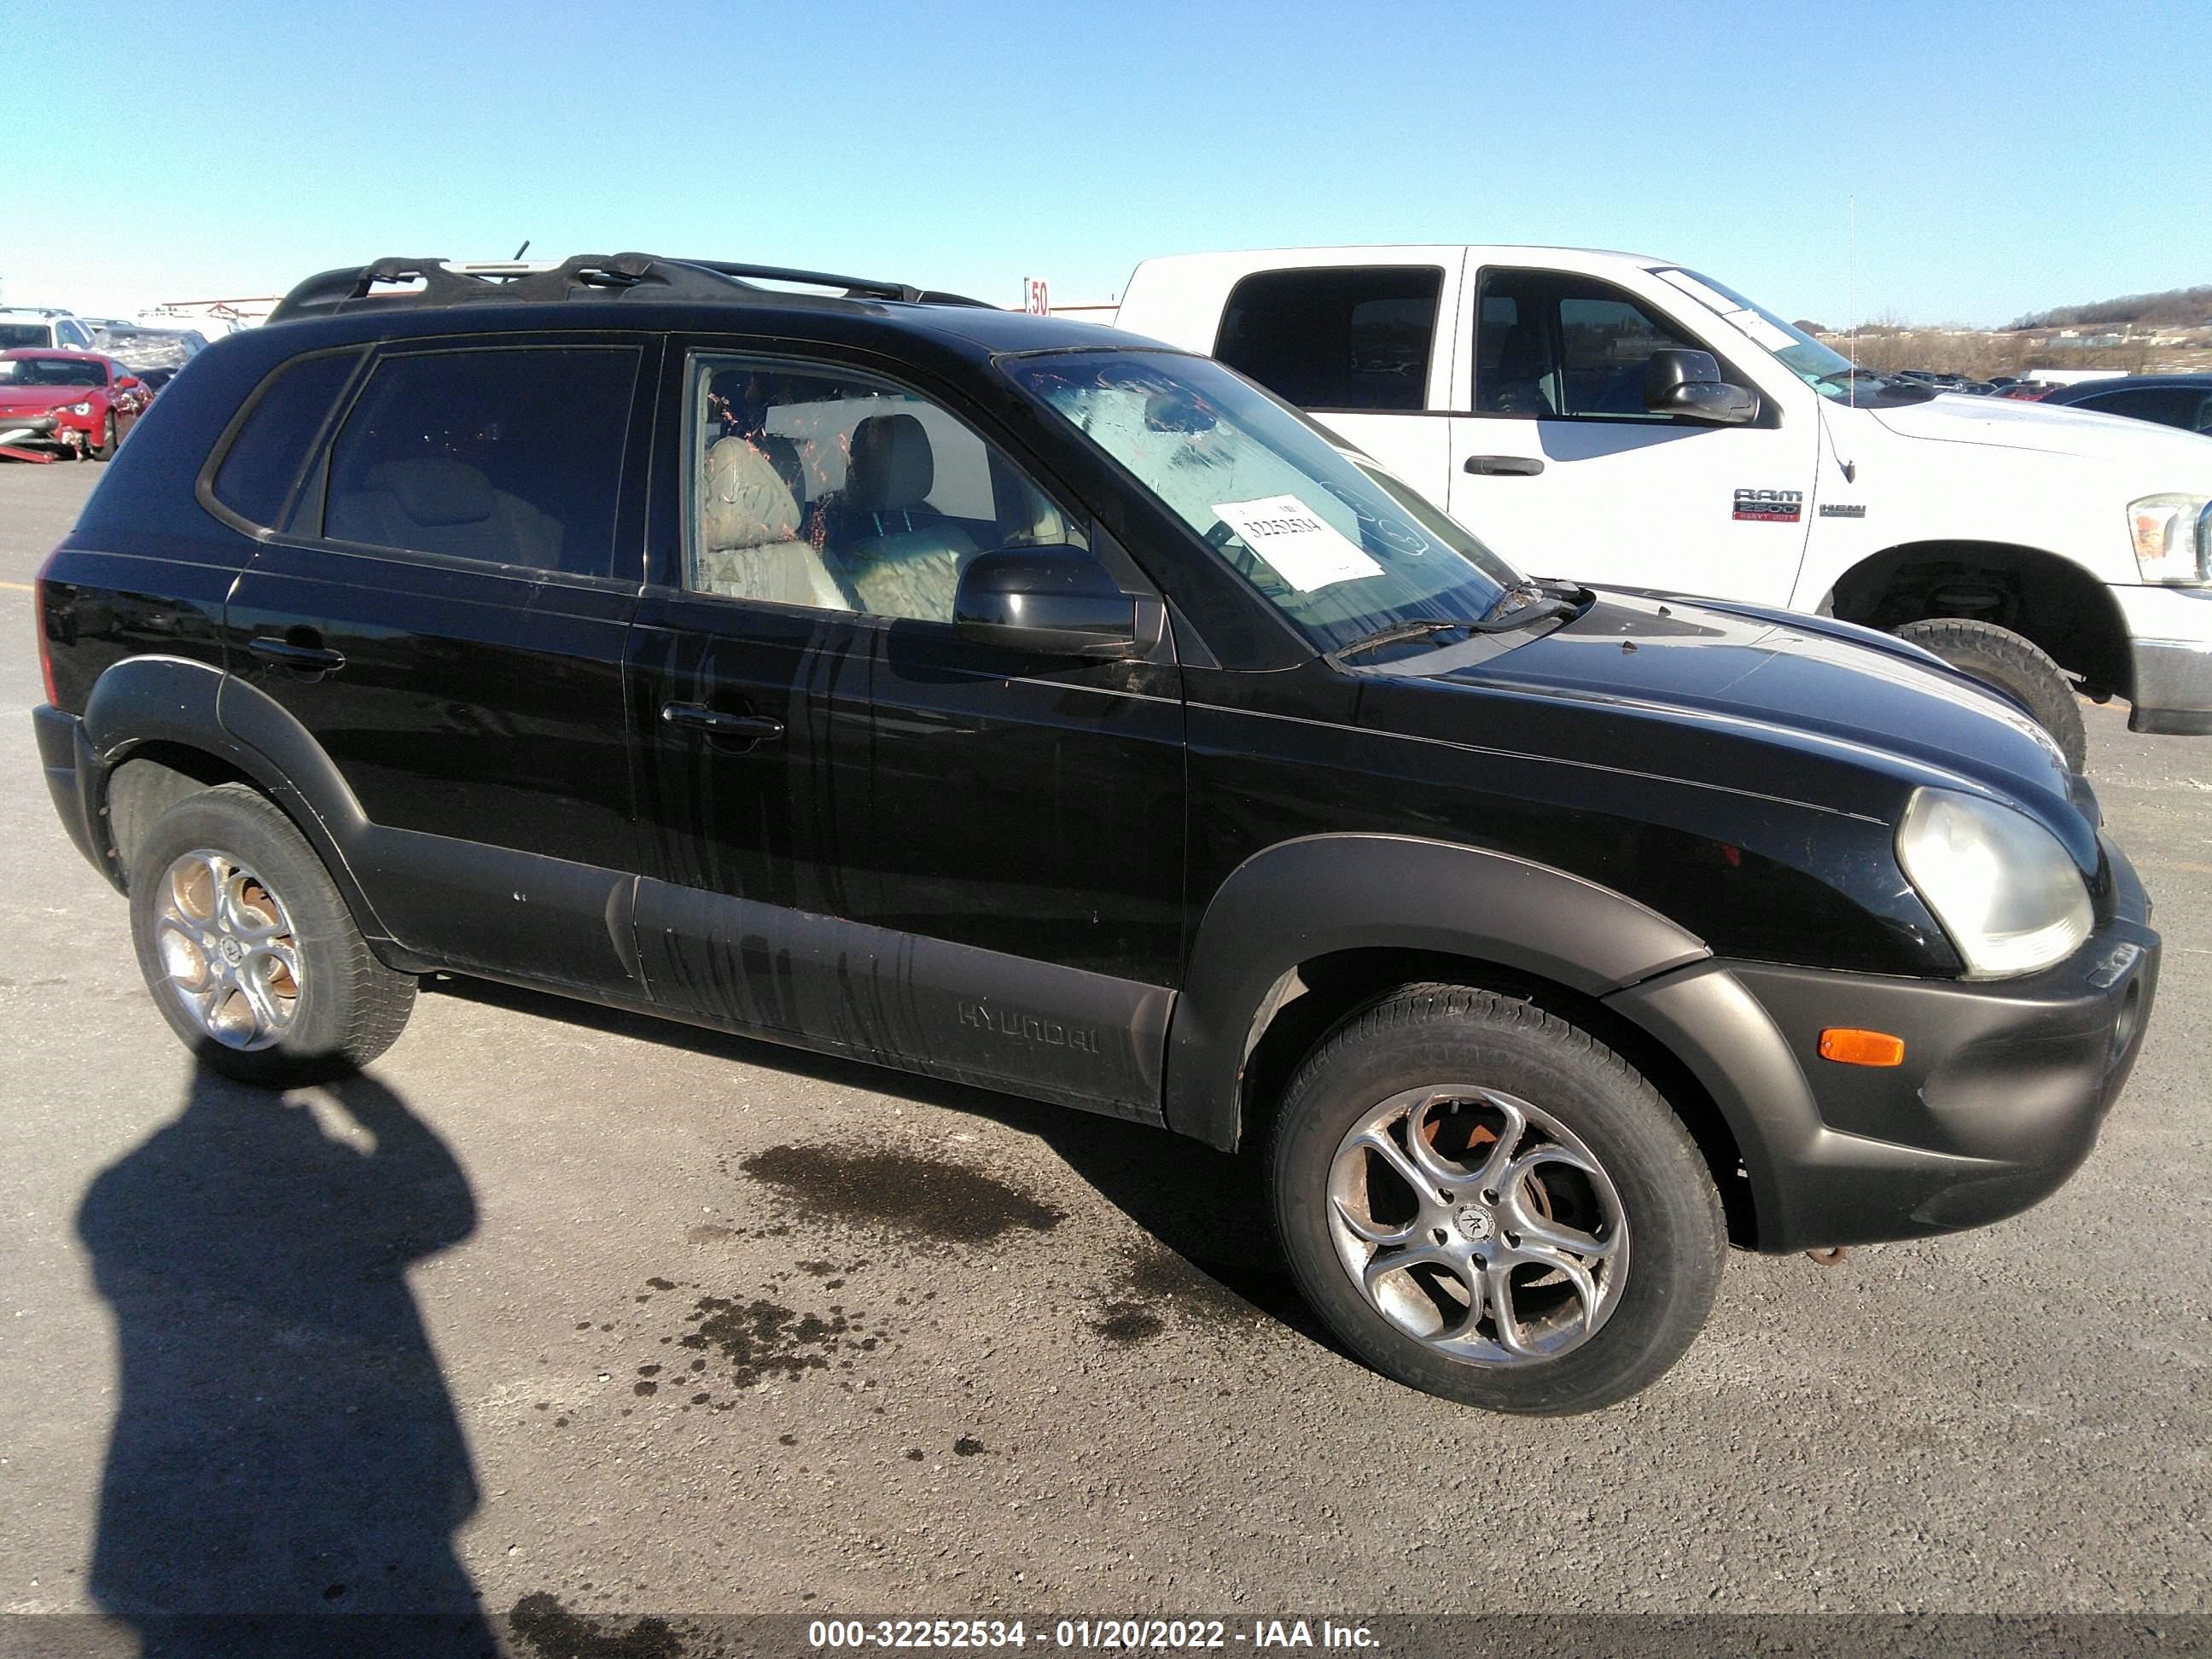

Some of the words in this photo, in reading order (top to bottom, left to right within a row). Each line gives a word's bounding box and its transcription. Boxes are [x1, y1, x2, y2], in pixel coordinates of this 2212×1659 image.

[1032, 281, 1048, 316] 50
[1734, 489, 1803, 503] RAM
[1740, 504, 1798, 514] 2500
[1819, 504, 1866, 512] HEMI
[1243, 518, 1322, 538] 32252534
[958, 1001, 1100, 1055] HYUNDAI
